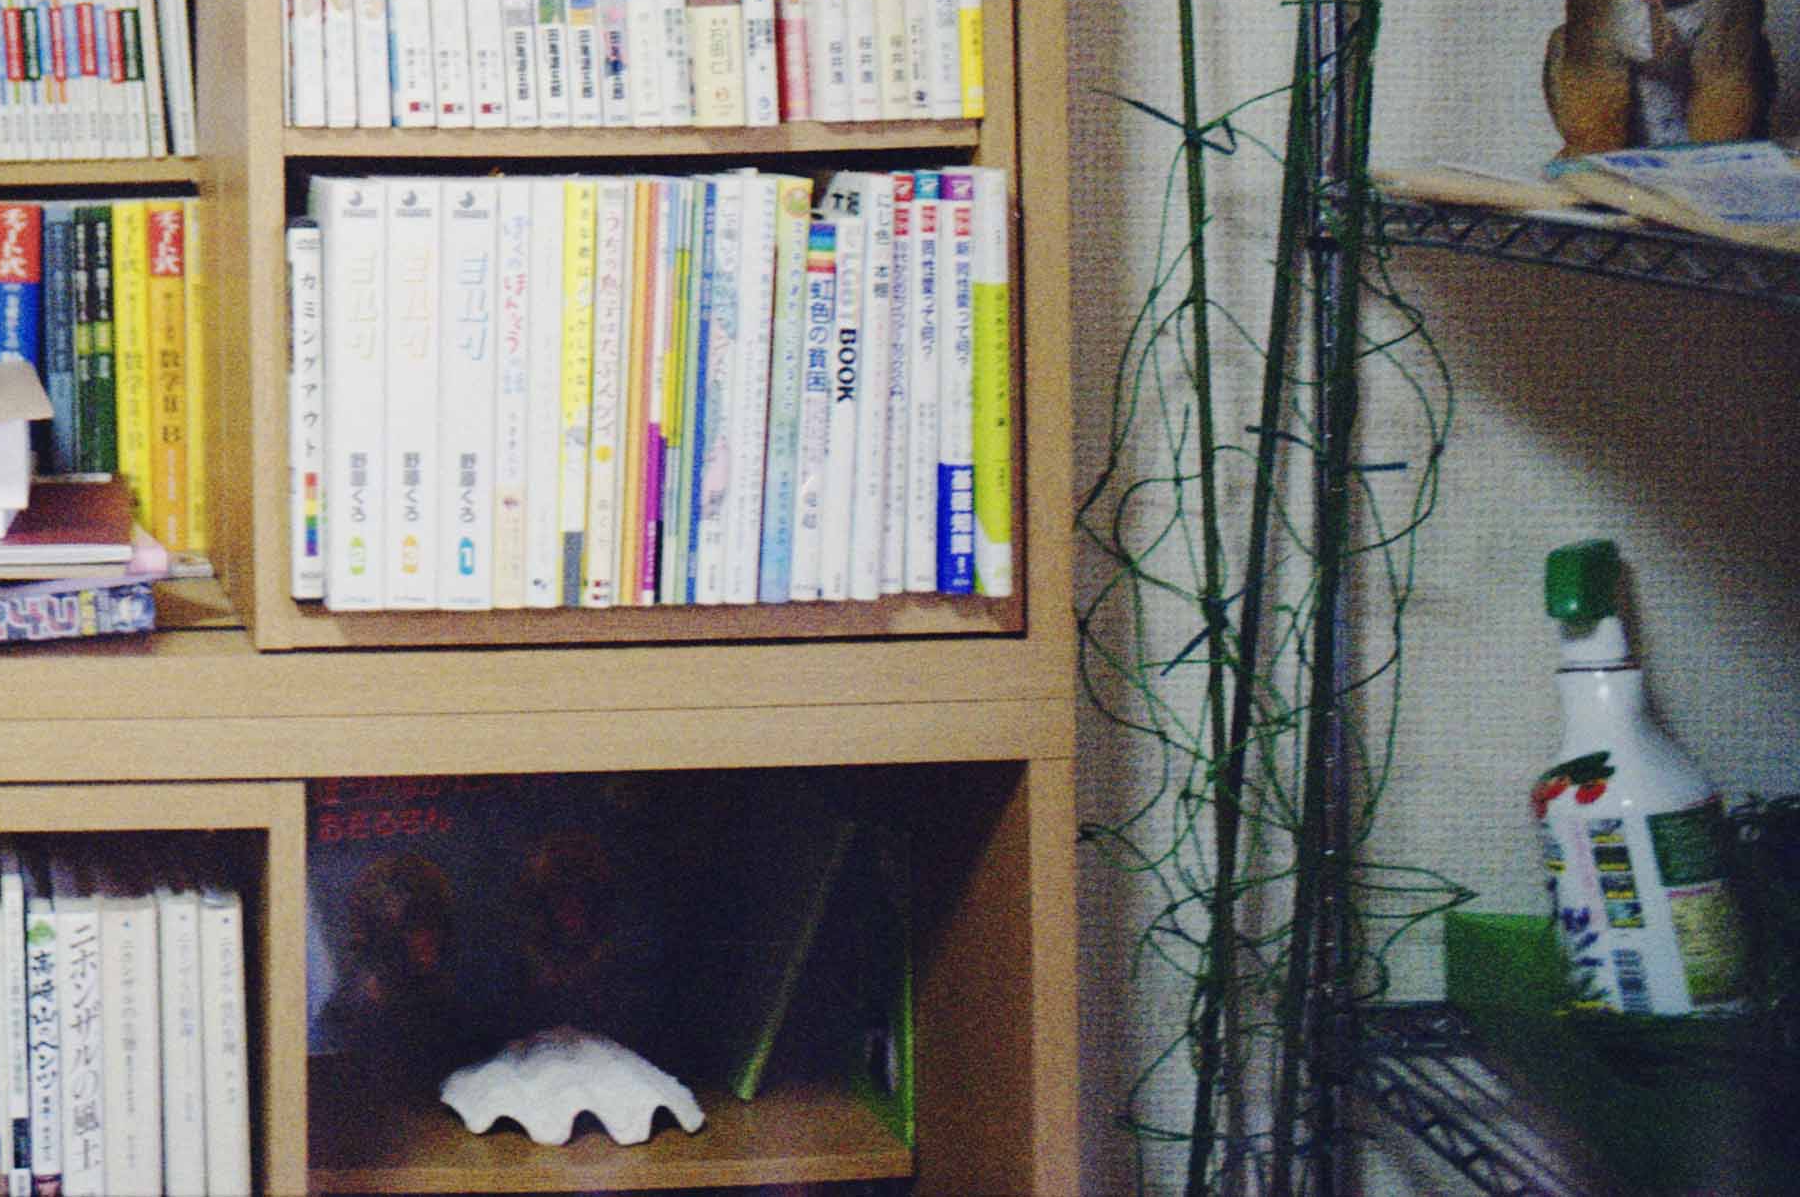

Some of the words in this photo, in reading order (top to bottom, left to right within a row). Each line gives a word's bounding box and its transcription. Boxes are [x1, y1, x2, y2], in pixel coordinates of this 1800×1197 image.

[298, 273, 319, 458] カミングアウト
[836, 327, 857, 402] BOOK
